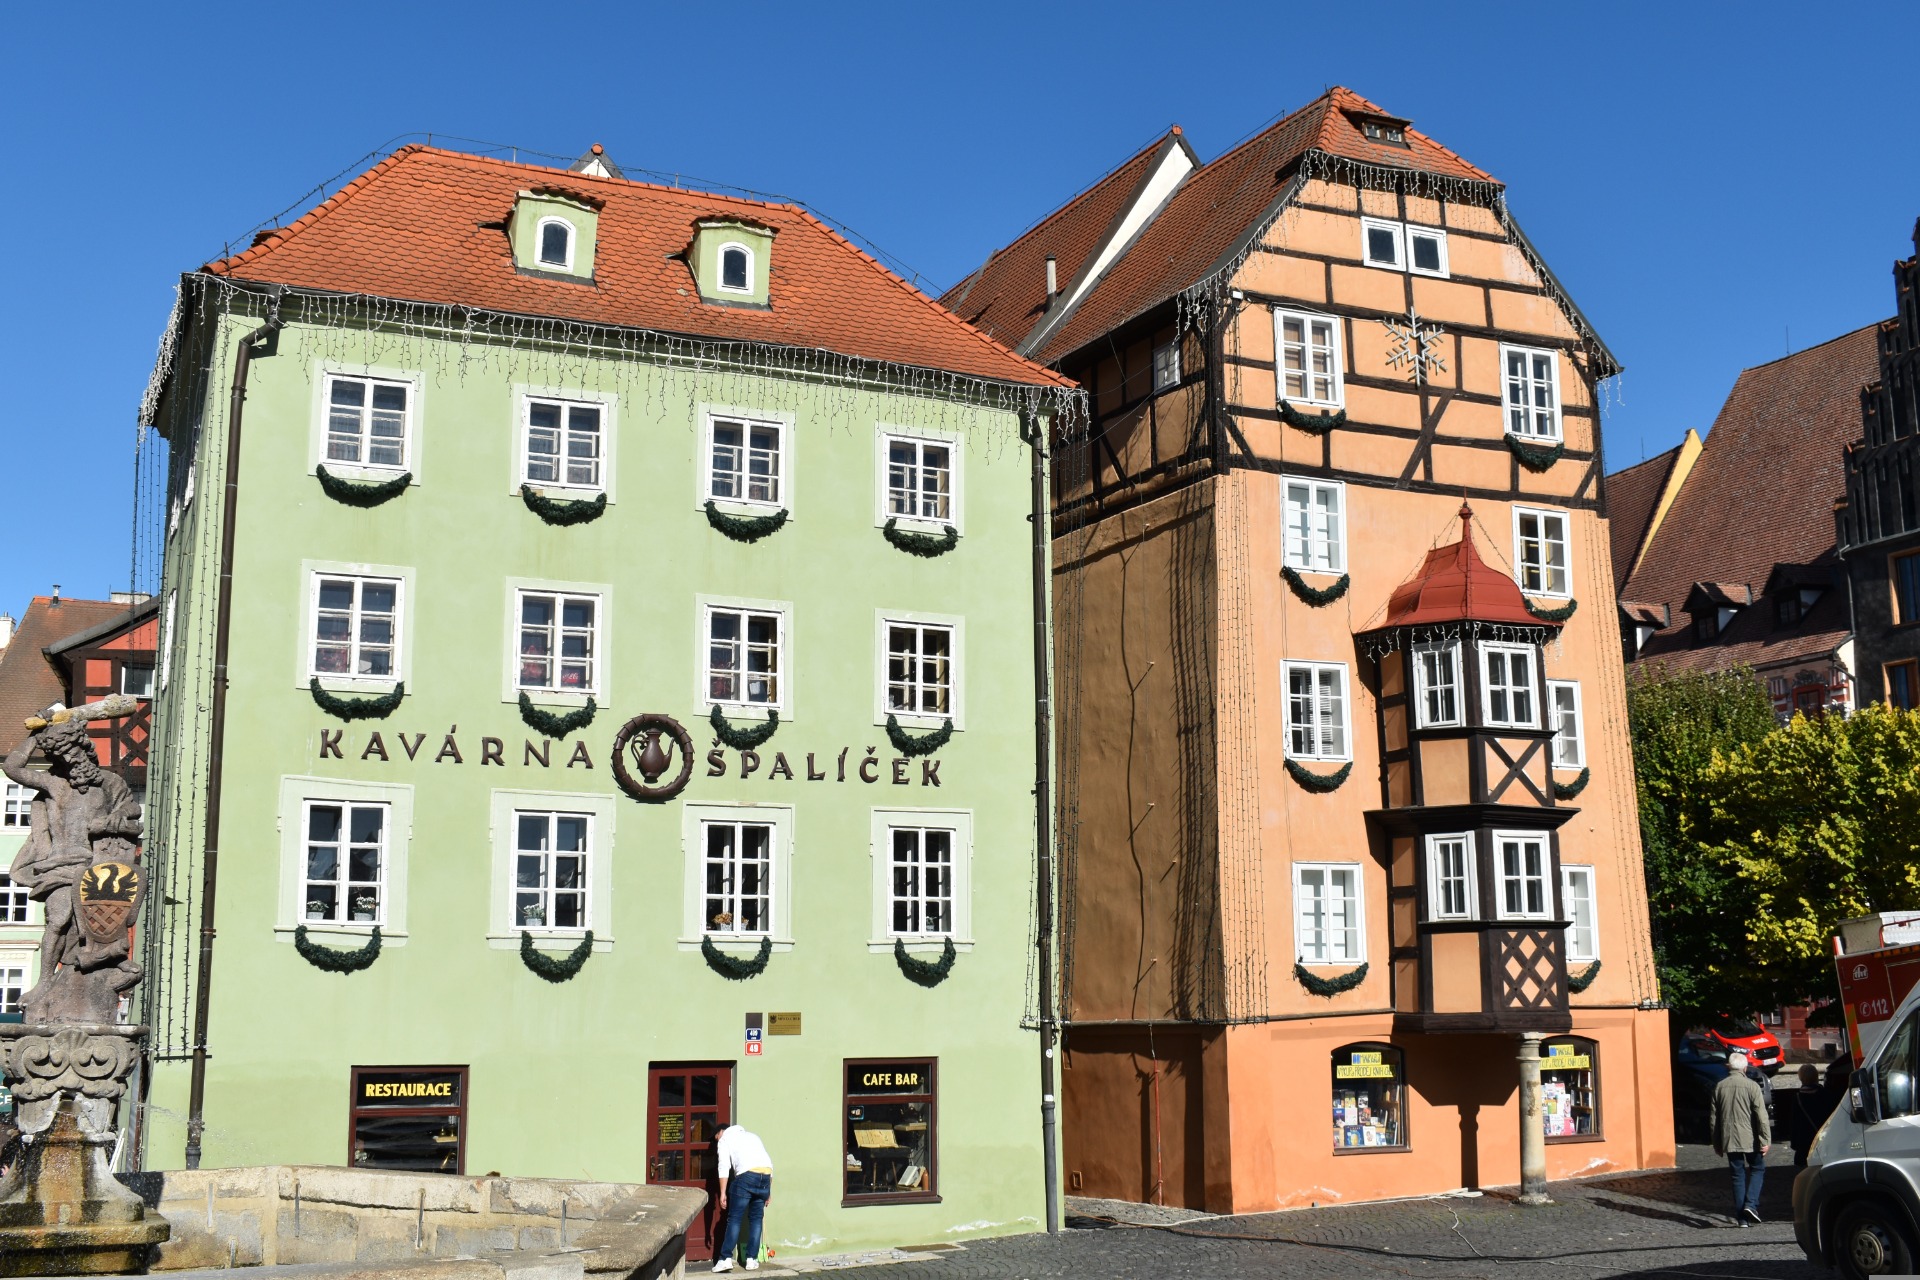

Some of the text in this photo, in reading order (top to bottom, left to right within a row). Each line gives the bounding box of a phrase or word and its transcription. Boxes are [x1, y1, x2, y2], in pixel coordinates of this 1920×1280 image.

[319, 724, 942, 788] KAVÁRNA ŠPALÍČEK
[1871, 998, 1889, 1016] 112
[749, 1043, 759, 1053] 49
[863, 1073, 918, 1086] CAFE BAR
[365, 1083, 452, 1097] RESTAURACE
